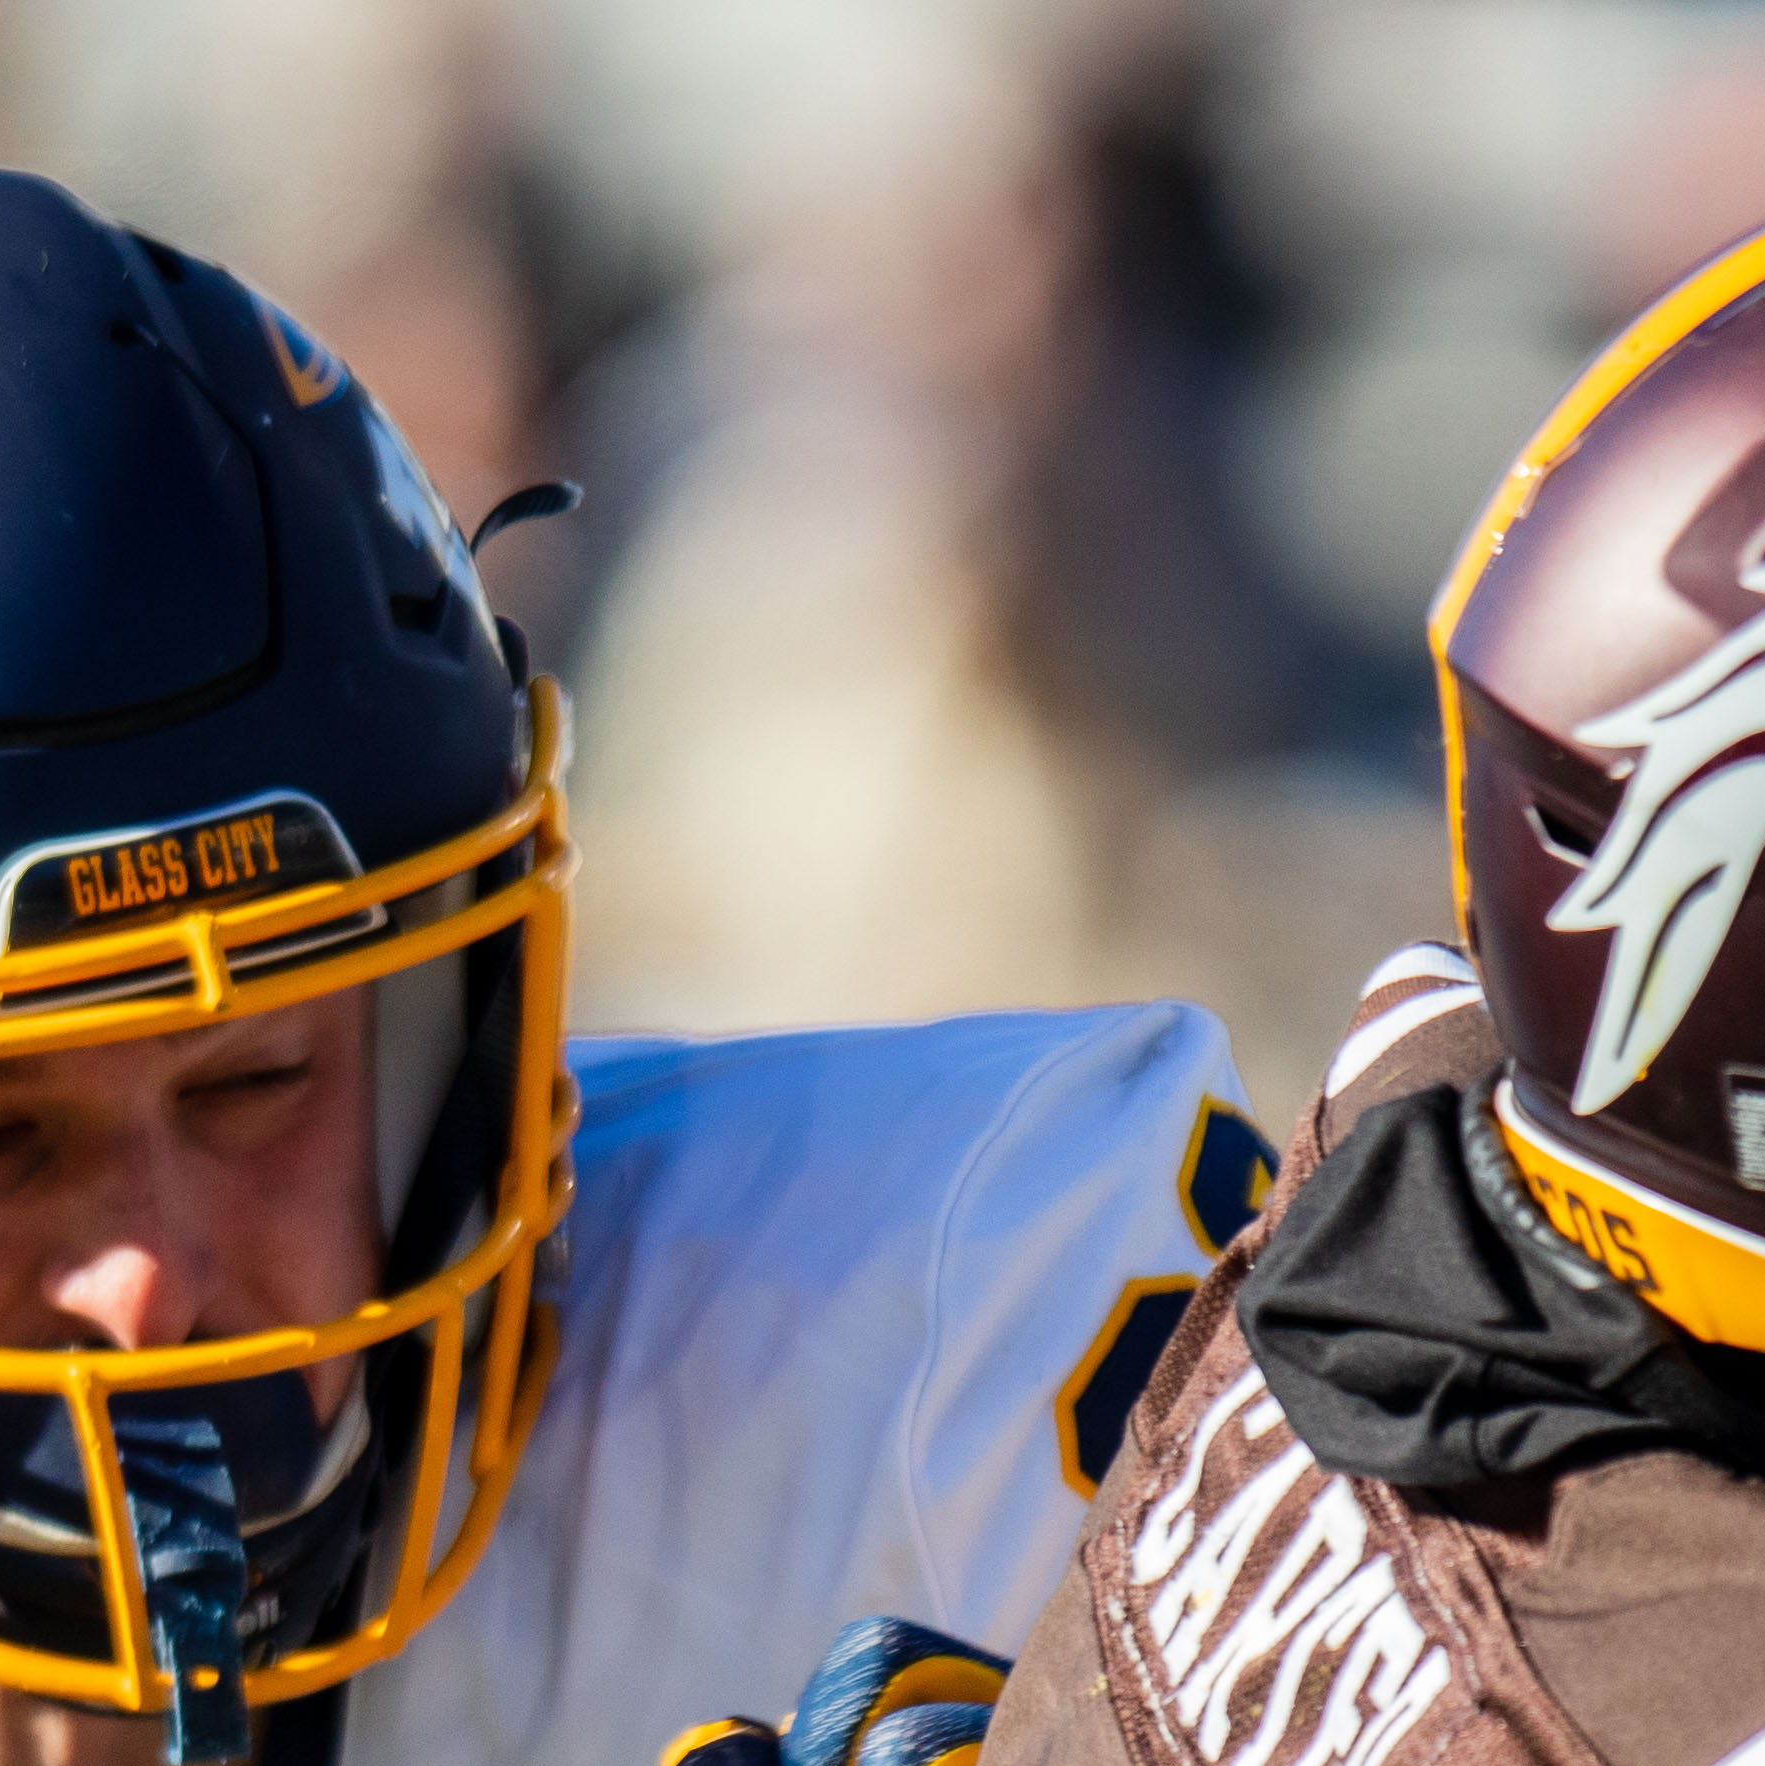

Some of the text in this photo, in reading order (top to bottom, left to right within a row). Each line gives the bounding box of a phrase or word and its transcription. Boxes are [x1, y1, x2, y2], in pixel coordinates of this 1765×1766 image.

[66, 812, 282, 918] GLASS CITY
[1534, 1173, 1662, 1294] OS
